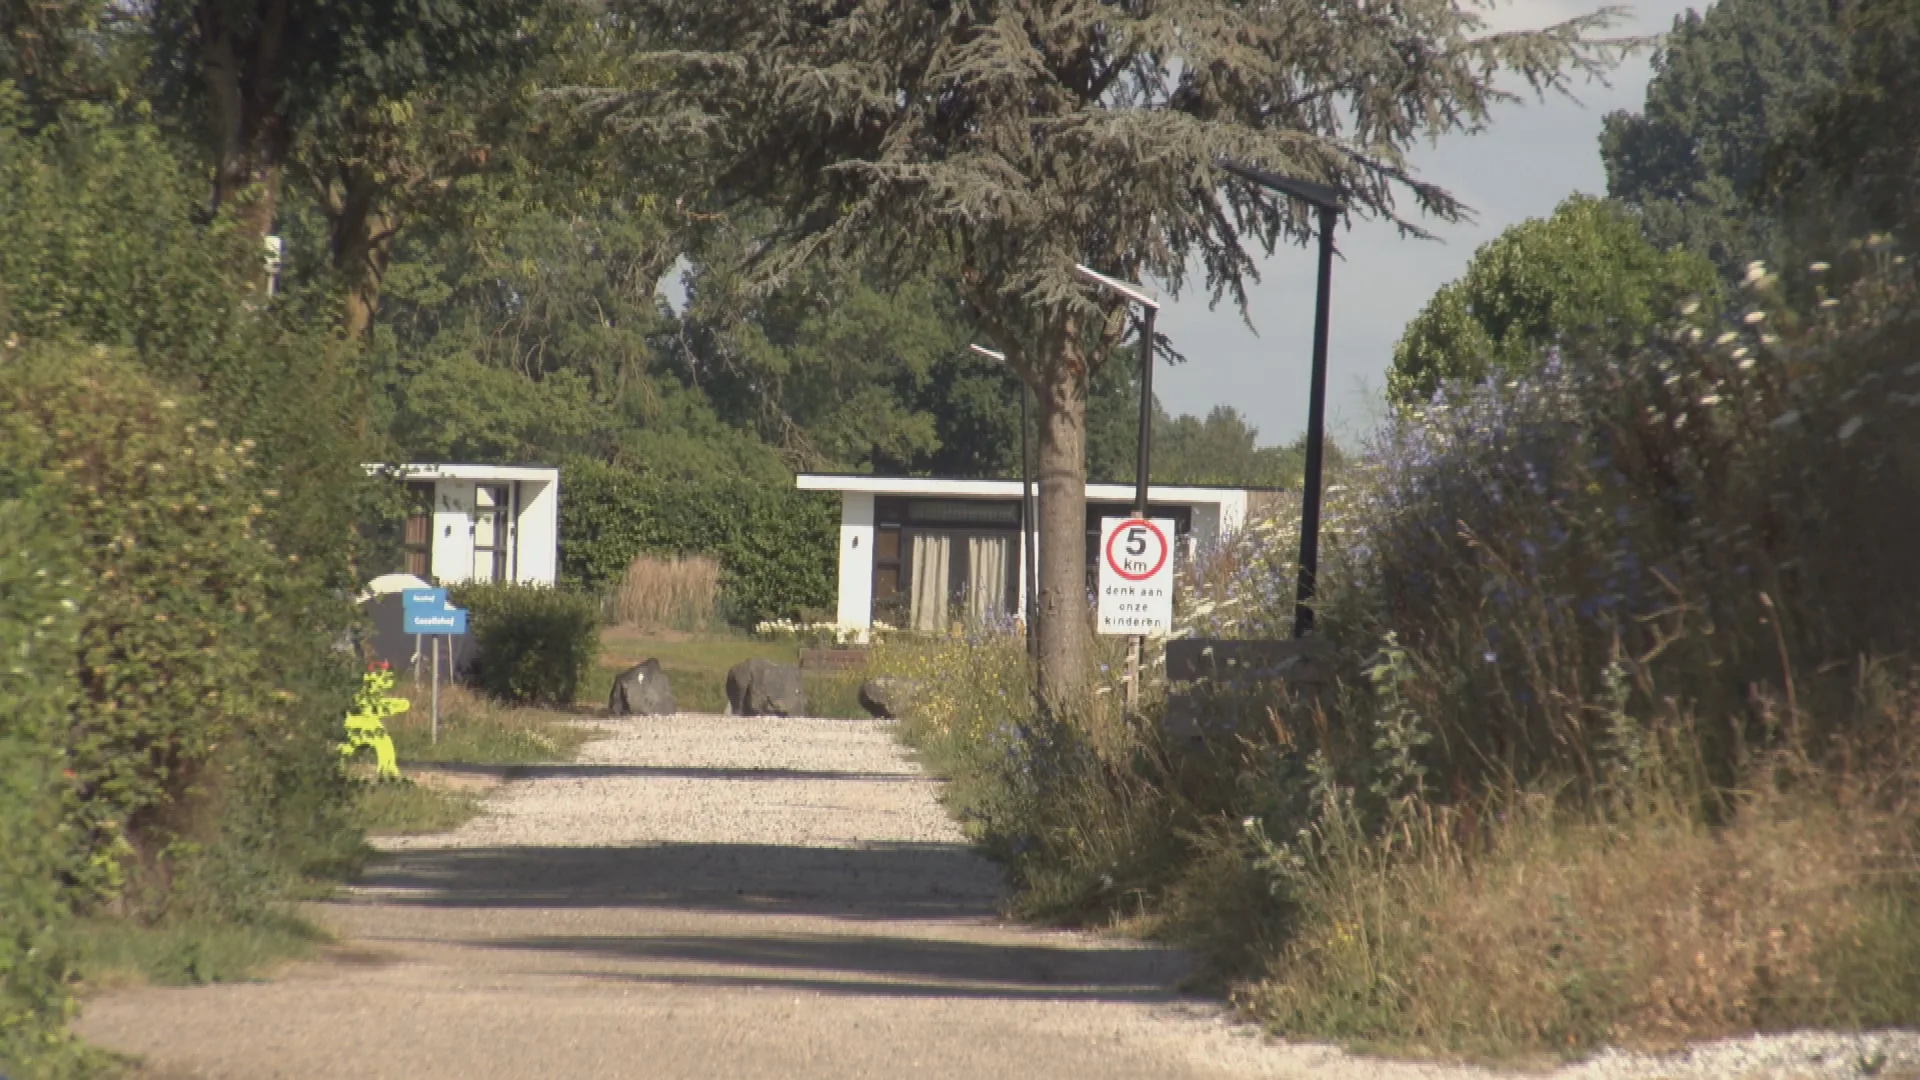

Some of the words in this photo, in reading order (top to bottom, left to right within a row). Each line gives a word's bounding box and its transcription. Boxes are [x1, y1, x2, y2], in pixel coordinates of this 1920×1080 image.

[1125, 527, 1147, 556] 5
[1123, 557, 1148, 572] km
[1105, 585, 1135, 597] denk
[1140, 588, 1163, 597] aan
[1119, 603, 1148, 611] onze
[1104, 616, 1161, 627] kinderen
